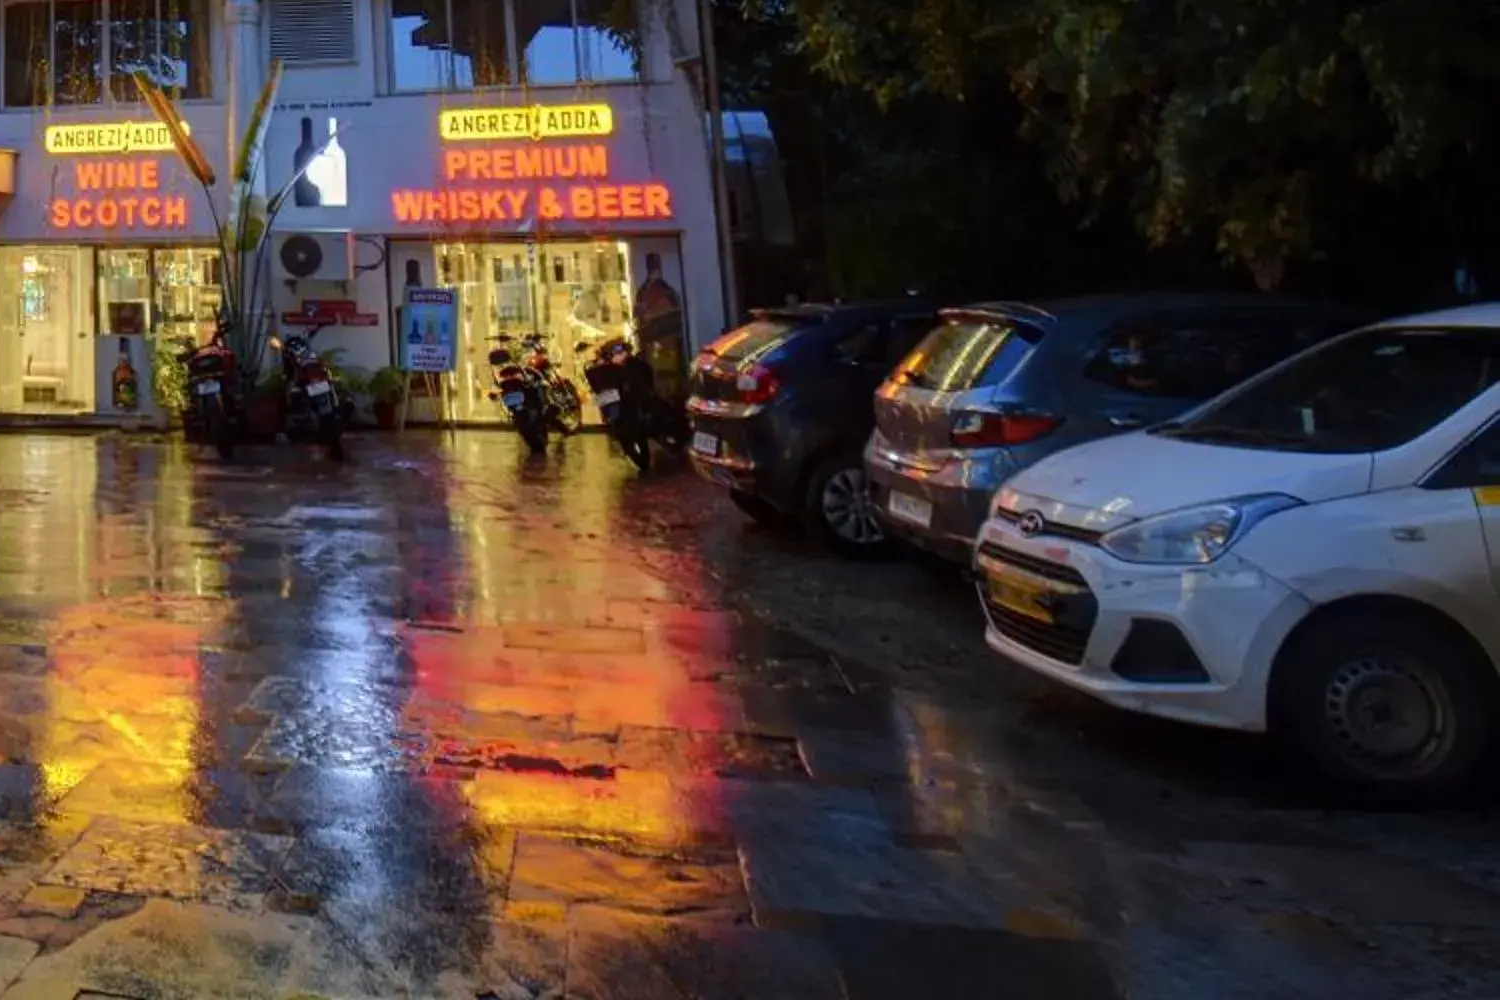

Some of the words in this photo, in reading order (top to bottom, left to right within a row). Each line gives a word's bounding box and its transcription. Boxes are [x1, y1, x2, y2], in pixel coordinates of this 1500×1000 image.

[53, 127, 122, 148] ANGREZI
[133, 126, 171, 146] ADD
[449, 113, 531, 135] ANGREZI
[547, 109, 602, 130] ADDA
[76, 160, 159, 190] WINE
[446, 145, 608, 180] PREMIUM
[51, 197, 186, 228] SCOTCH
[391, 188, 529, 221] WHISKY
[538, 187, 564, 219] &
[569, 184, 673, 219] BEER
